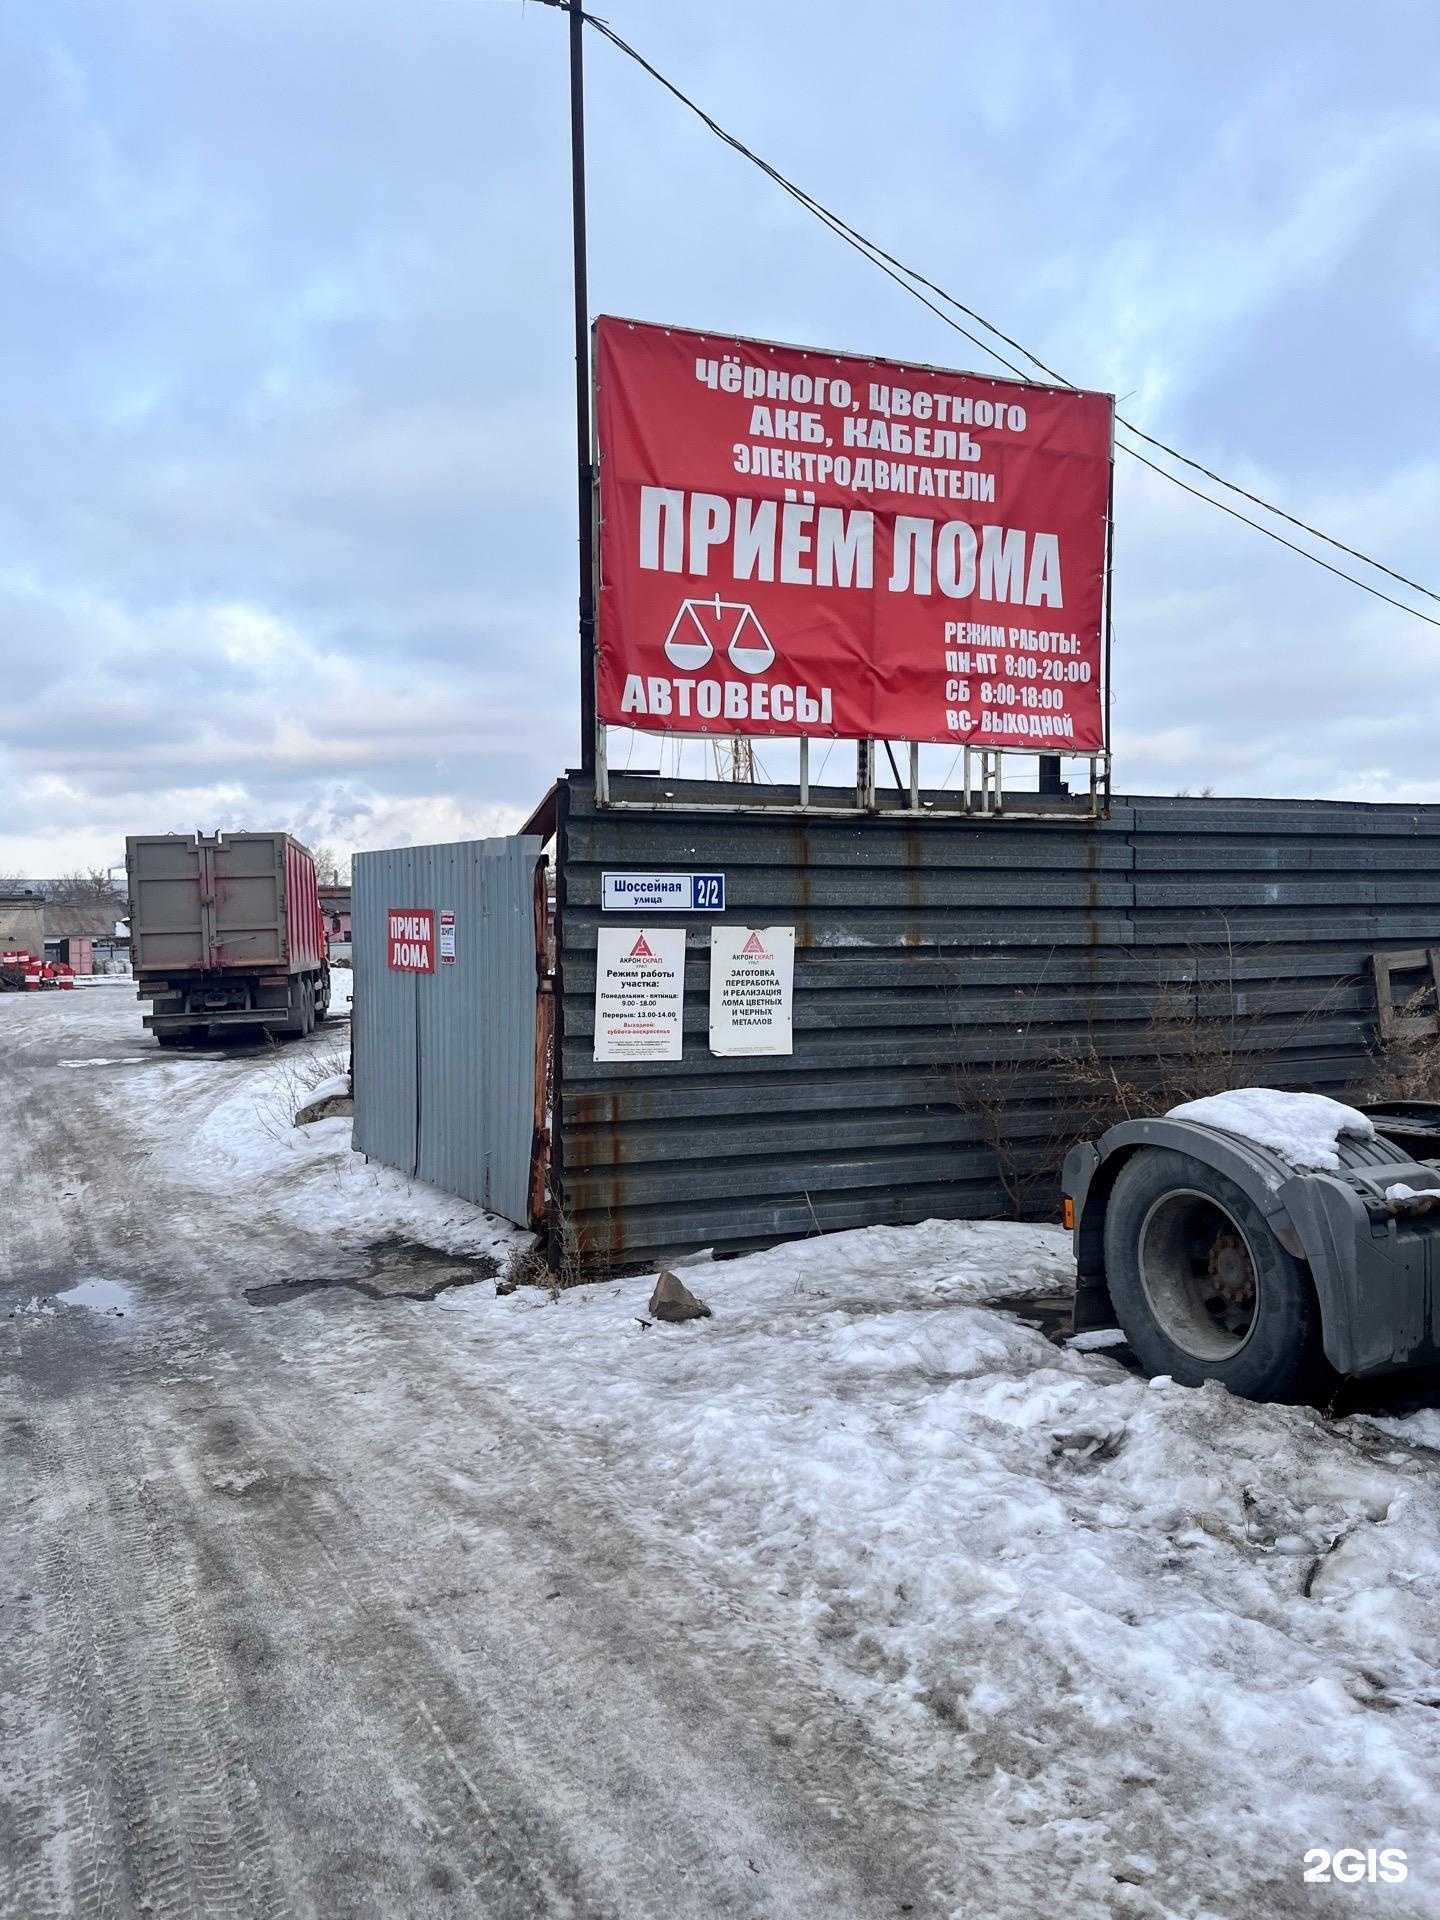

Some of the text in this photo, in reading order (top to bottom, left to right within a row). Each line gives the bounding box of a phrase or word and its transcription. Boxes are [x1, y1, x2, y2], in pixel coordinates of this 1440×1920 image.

[695, 355, 1027, 432] чёрного, цветного
[749, 405, 982, 462] АКБ, КАБЕЛЬ
[732, 443, 996, 503] ЭЛЕКТРОДВИГАТЕЛИ
[639, 485, 1064, 609] ПРИЁМ ЛОМА
[944, 621, 1081, 655] РЕЖИМ РАБОТЫ:
[945, 650, 1091, 683] ПН-ПТ 8:00-20:00
[621, 674, 833, 725] АВТОВЕСЫ
[945, 679, 1064, 710] СБ 8:00-18:00
[945, 709, 1074, 738] ВС- ВЫХОДНОЙ
[614, 878, 682, 892] Шоссейная
[697, 879, 719, 907] 2/2
[633, 896, 662, 905] улица
[390, 916, 430, 941] ПРИЕМ
[393, 943, 429, 968] ЛОМА
[620, 981, 659, 989] участка:
[641, 969, 675, 979] работы
[730, 989, 782, 997] РЕАЛИЗАЦИЯ
